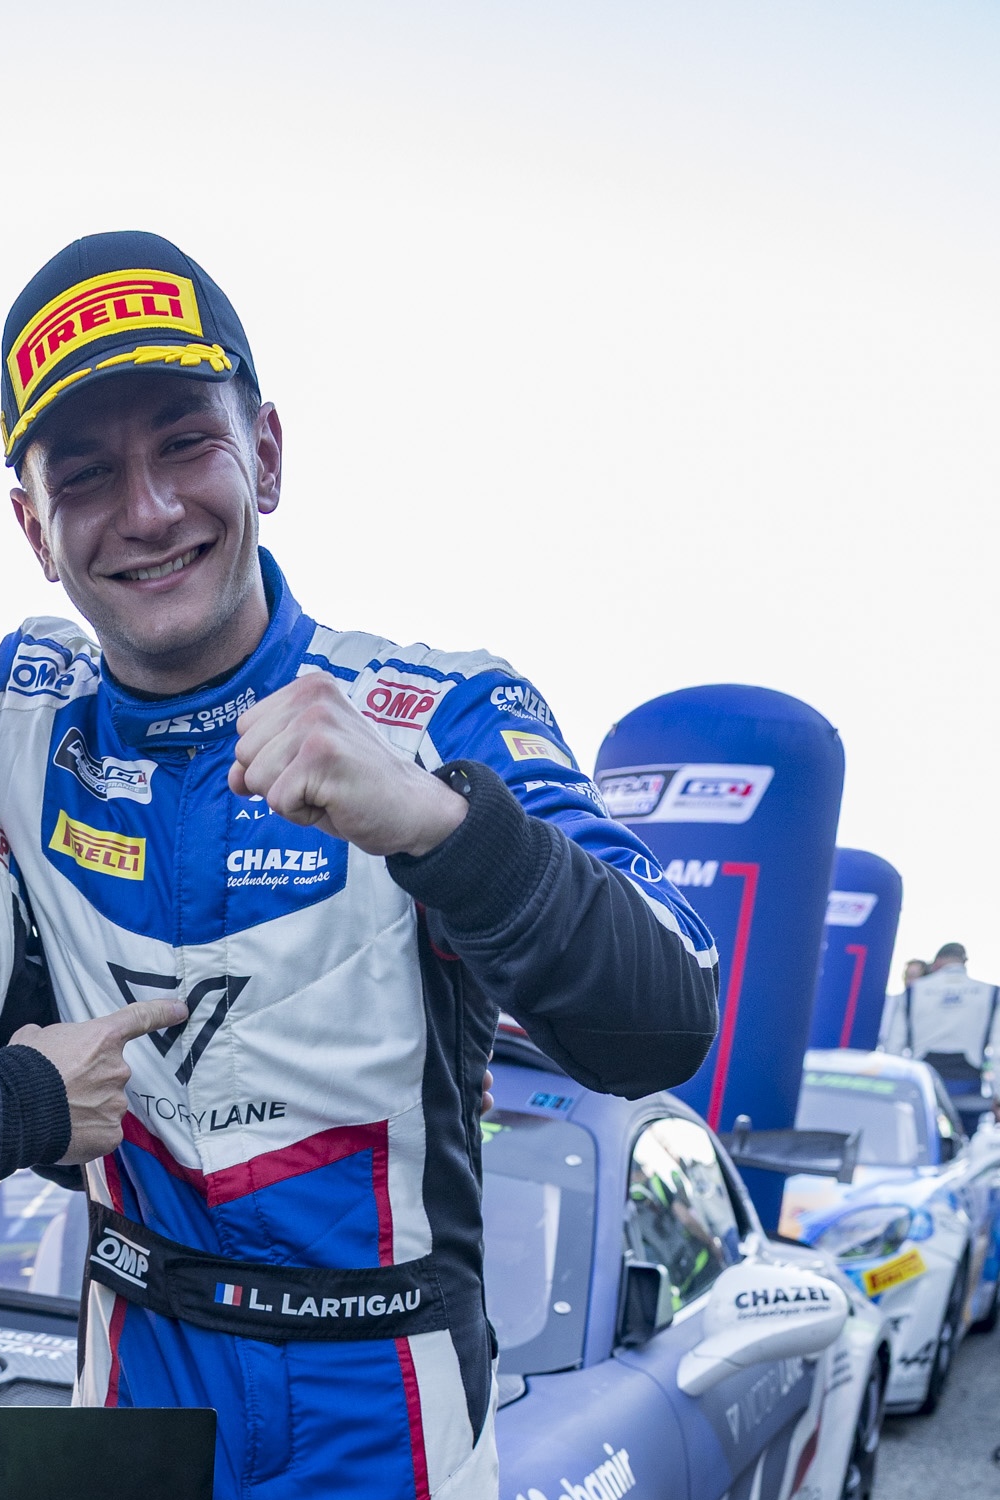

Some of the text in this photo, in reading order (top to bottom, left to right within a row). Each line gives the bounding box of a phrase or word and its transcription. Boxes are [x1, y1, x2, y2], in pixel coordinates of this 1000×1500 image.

[16, 280, 183, 390] PIRELLI
[12, 663, 75, 691] OMP
[197, 687, 255, 721] ORECA
[203, 695, 256, 732] STORE
[366, 687, 434, 719] OMP
[490, 686, 554, 727] CHAZEL
[63, 820, 140, 872] PIRELLI
[227, 847, 328, 873] CHAZEL
[227, 871, 330, 890] technologie course
[96, 1237, 149, 1278] OMP
[250, 1288, 421, 1319] L. LARTIGAU
[735, 1286, 830, 1310] CHAZEL
